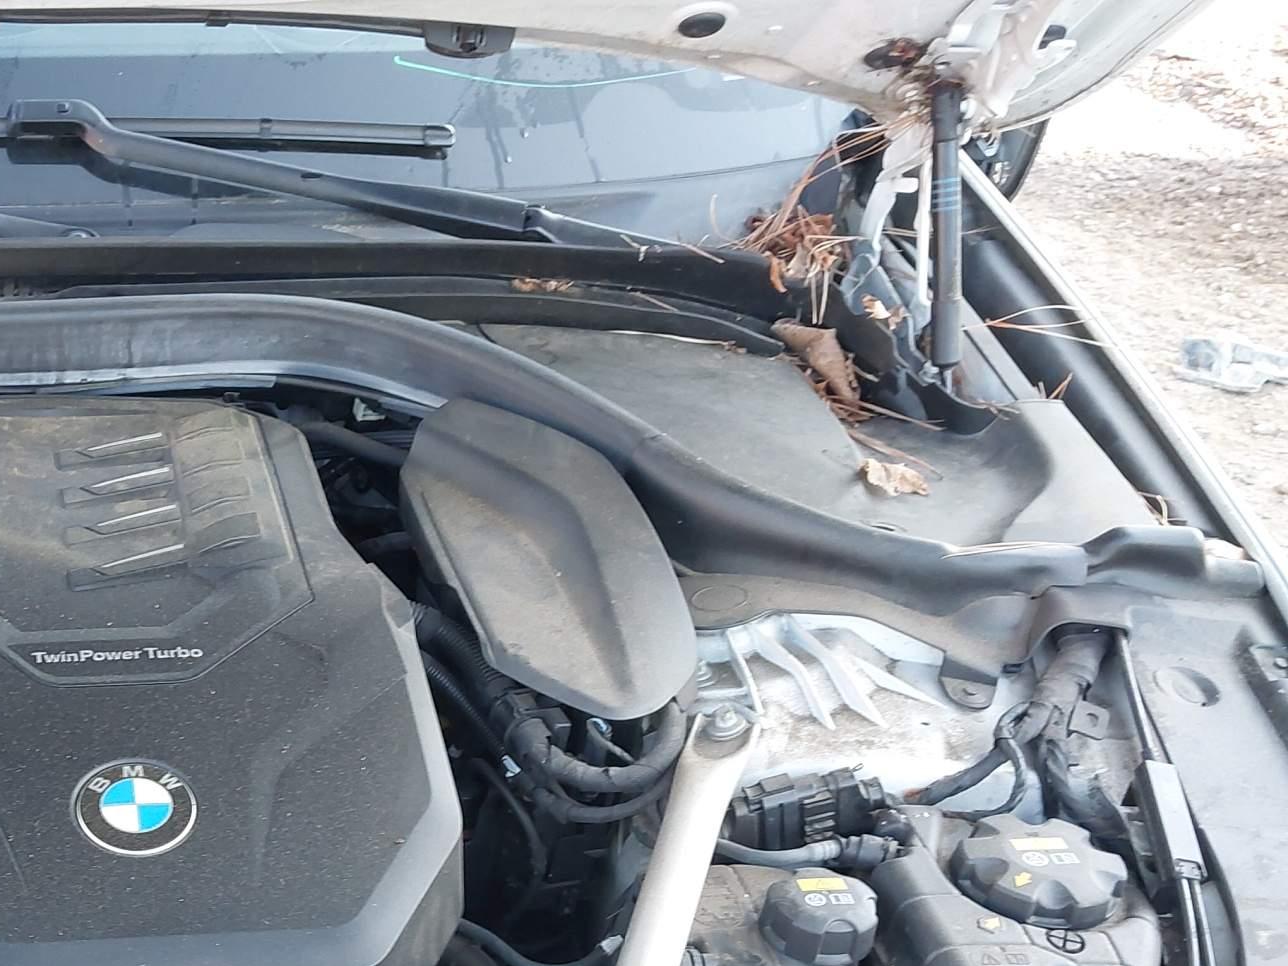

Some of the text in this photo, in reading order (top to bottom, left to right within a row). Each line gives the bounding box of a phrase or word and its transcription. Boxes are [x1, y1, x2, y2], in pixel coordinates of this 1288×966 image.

[31, 646, 204, 664] TwinPower Turbo
[88, 765, 184, 794] BMW
